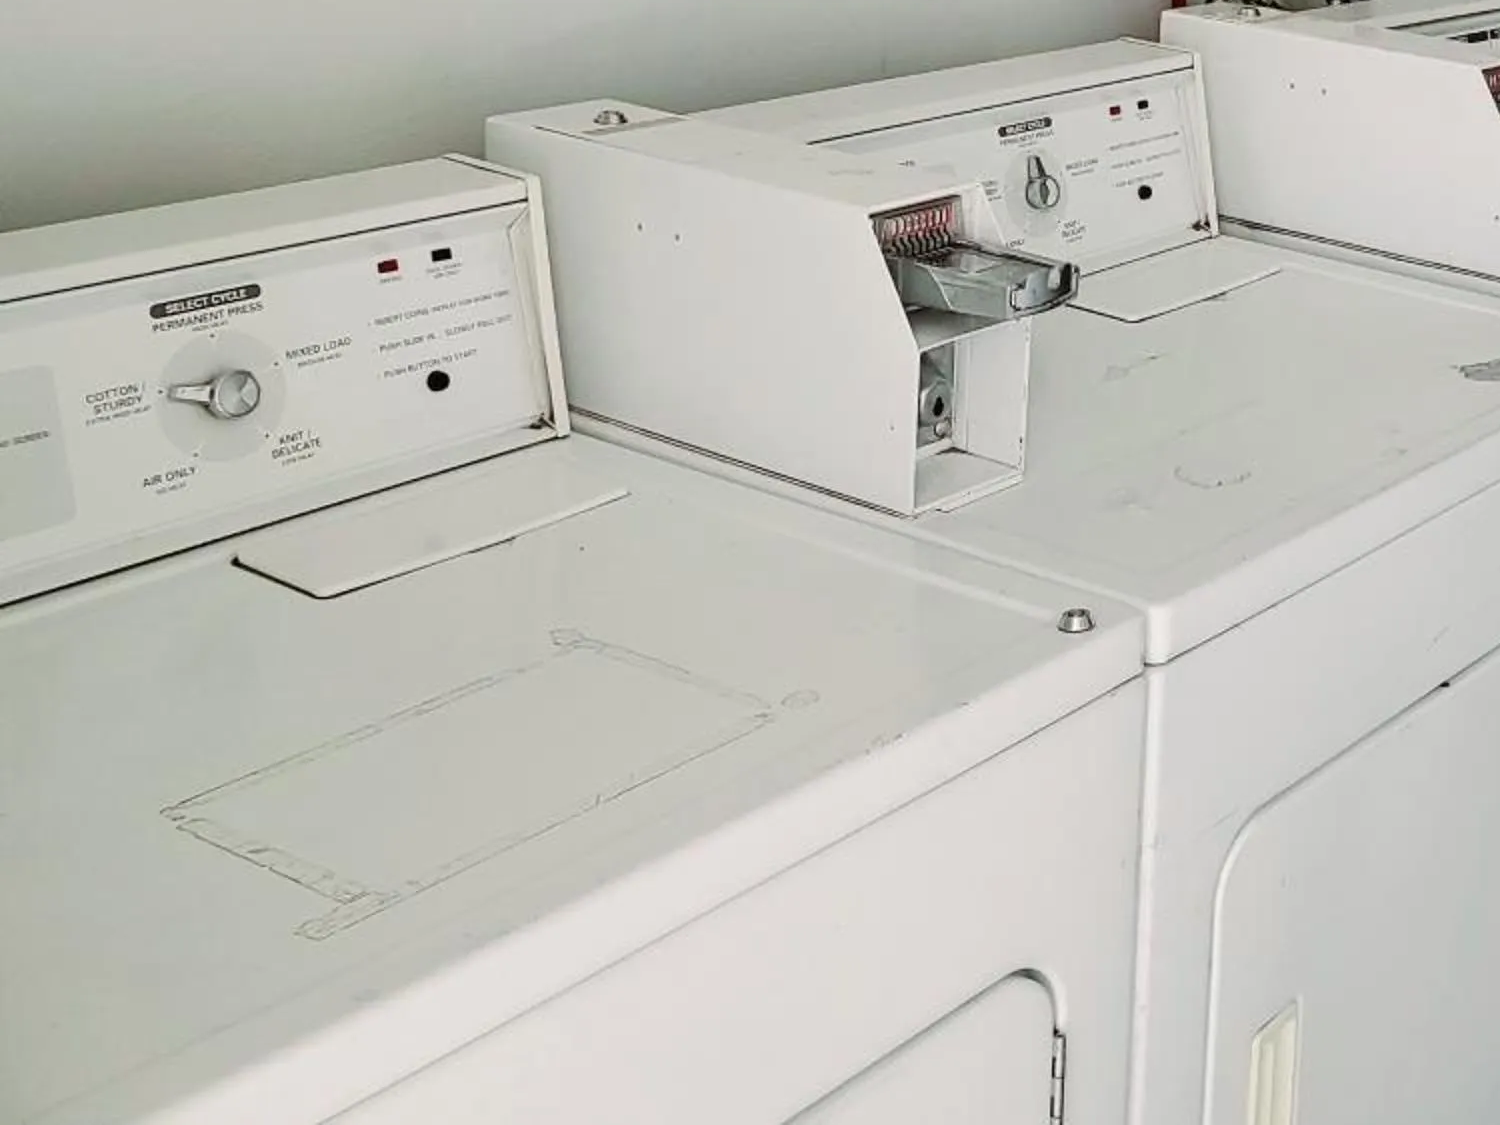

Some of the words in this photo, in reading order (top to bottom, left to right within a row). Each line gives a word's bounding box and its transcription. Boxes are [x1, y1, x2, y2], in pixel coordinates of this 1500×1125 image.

[165, 296, 209, 313] SELECT
[211, 288, 248, 305] CYCLE
[152, 310, 224, 332] PERMANENT
[227, 301, 264, 317] PRESS
[285, 344, 320, 360] MIXED
[323, 335, 353, 352] LOAD
[86, 384, 138, 404] COTTON
[93, 395, 143, 414] STURDY
[271, 437, 321, 459] DELICATE
[143, 474, 162, 488] AIR
[165, 466, 196, 482] ONLY
